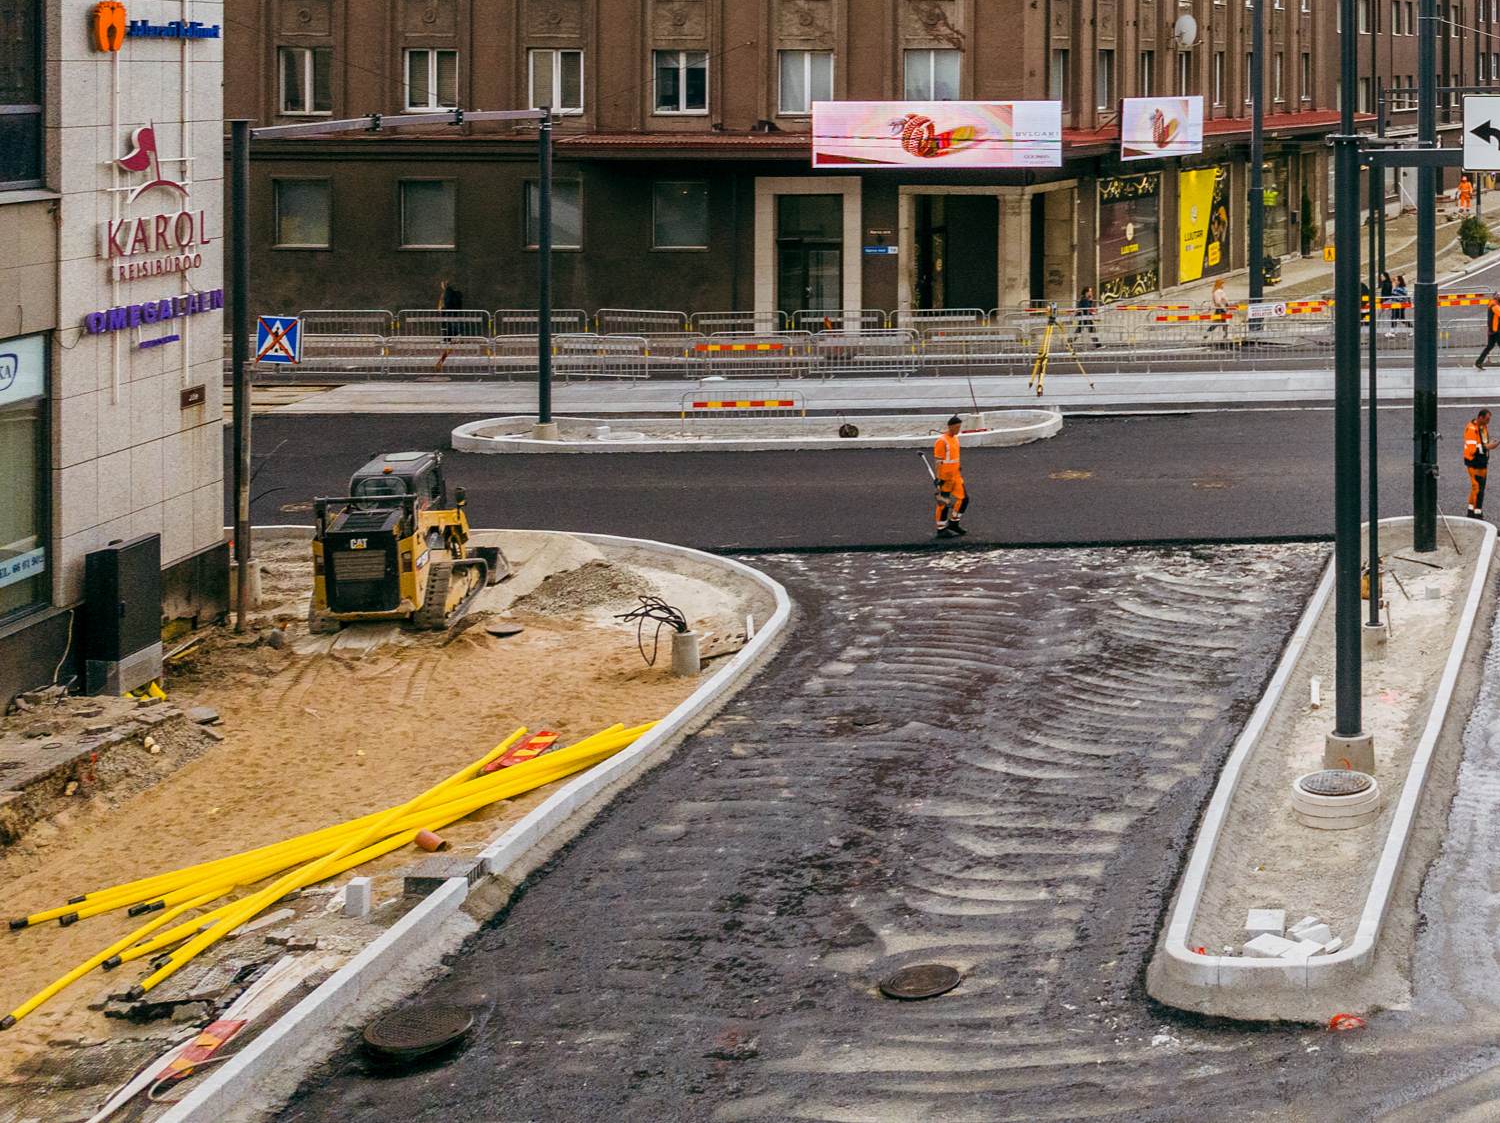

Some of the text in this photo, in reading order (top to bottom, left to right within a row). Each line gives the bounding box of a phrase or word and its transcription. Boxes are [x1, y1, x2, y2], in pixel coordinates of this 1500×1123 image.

[105, 210, 211, 259] KAROL
[118, 253, 202, 283] REISIBÜROO
[85, 288, 224, 334] OMEGALAEN
[350, 538, 368, 549] CAT
